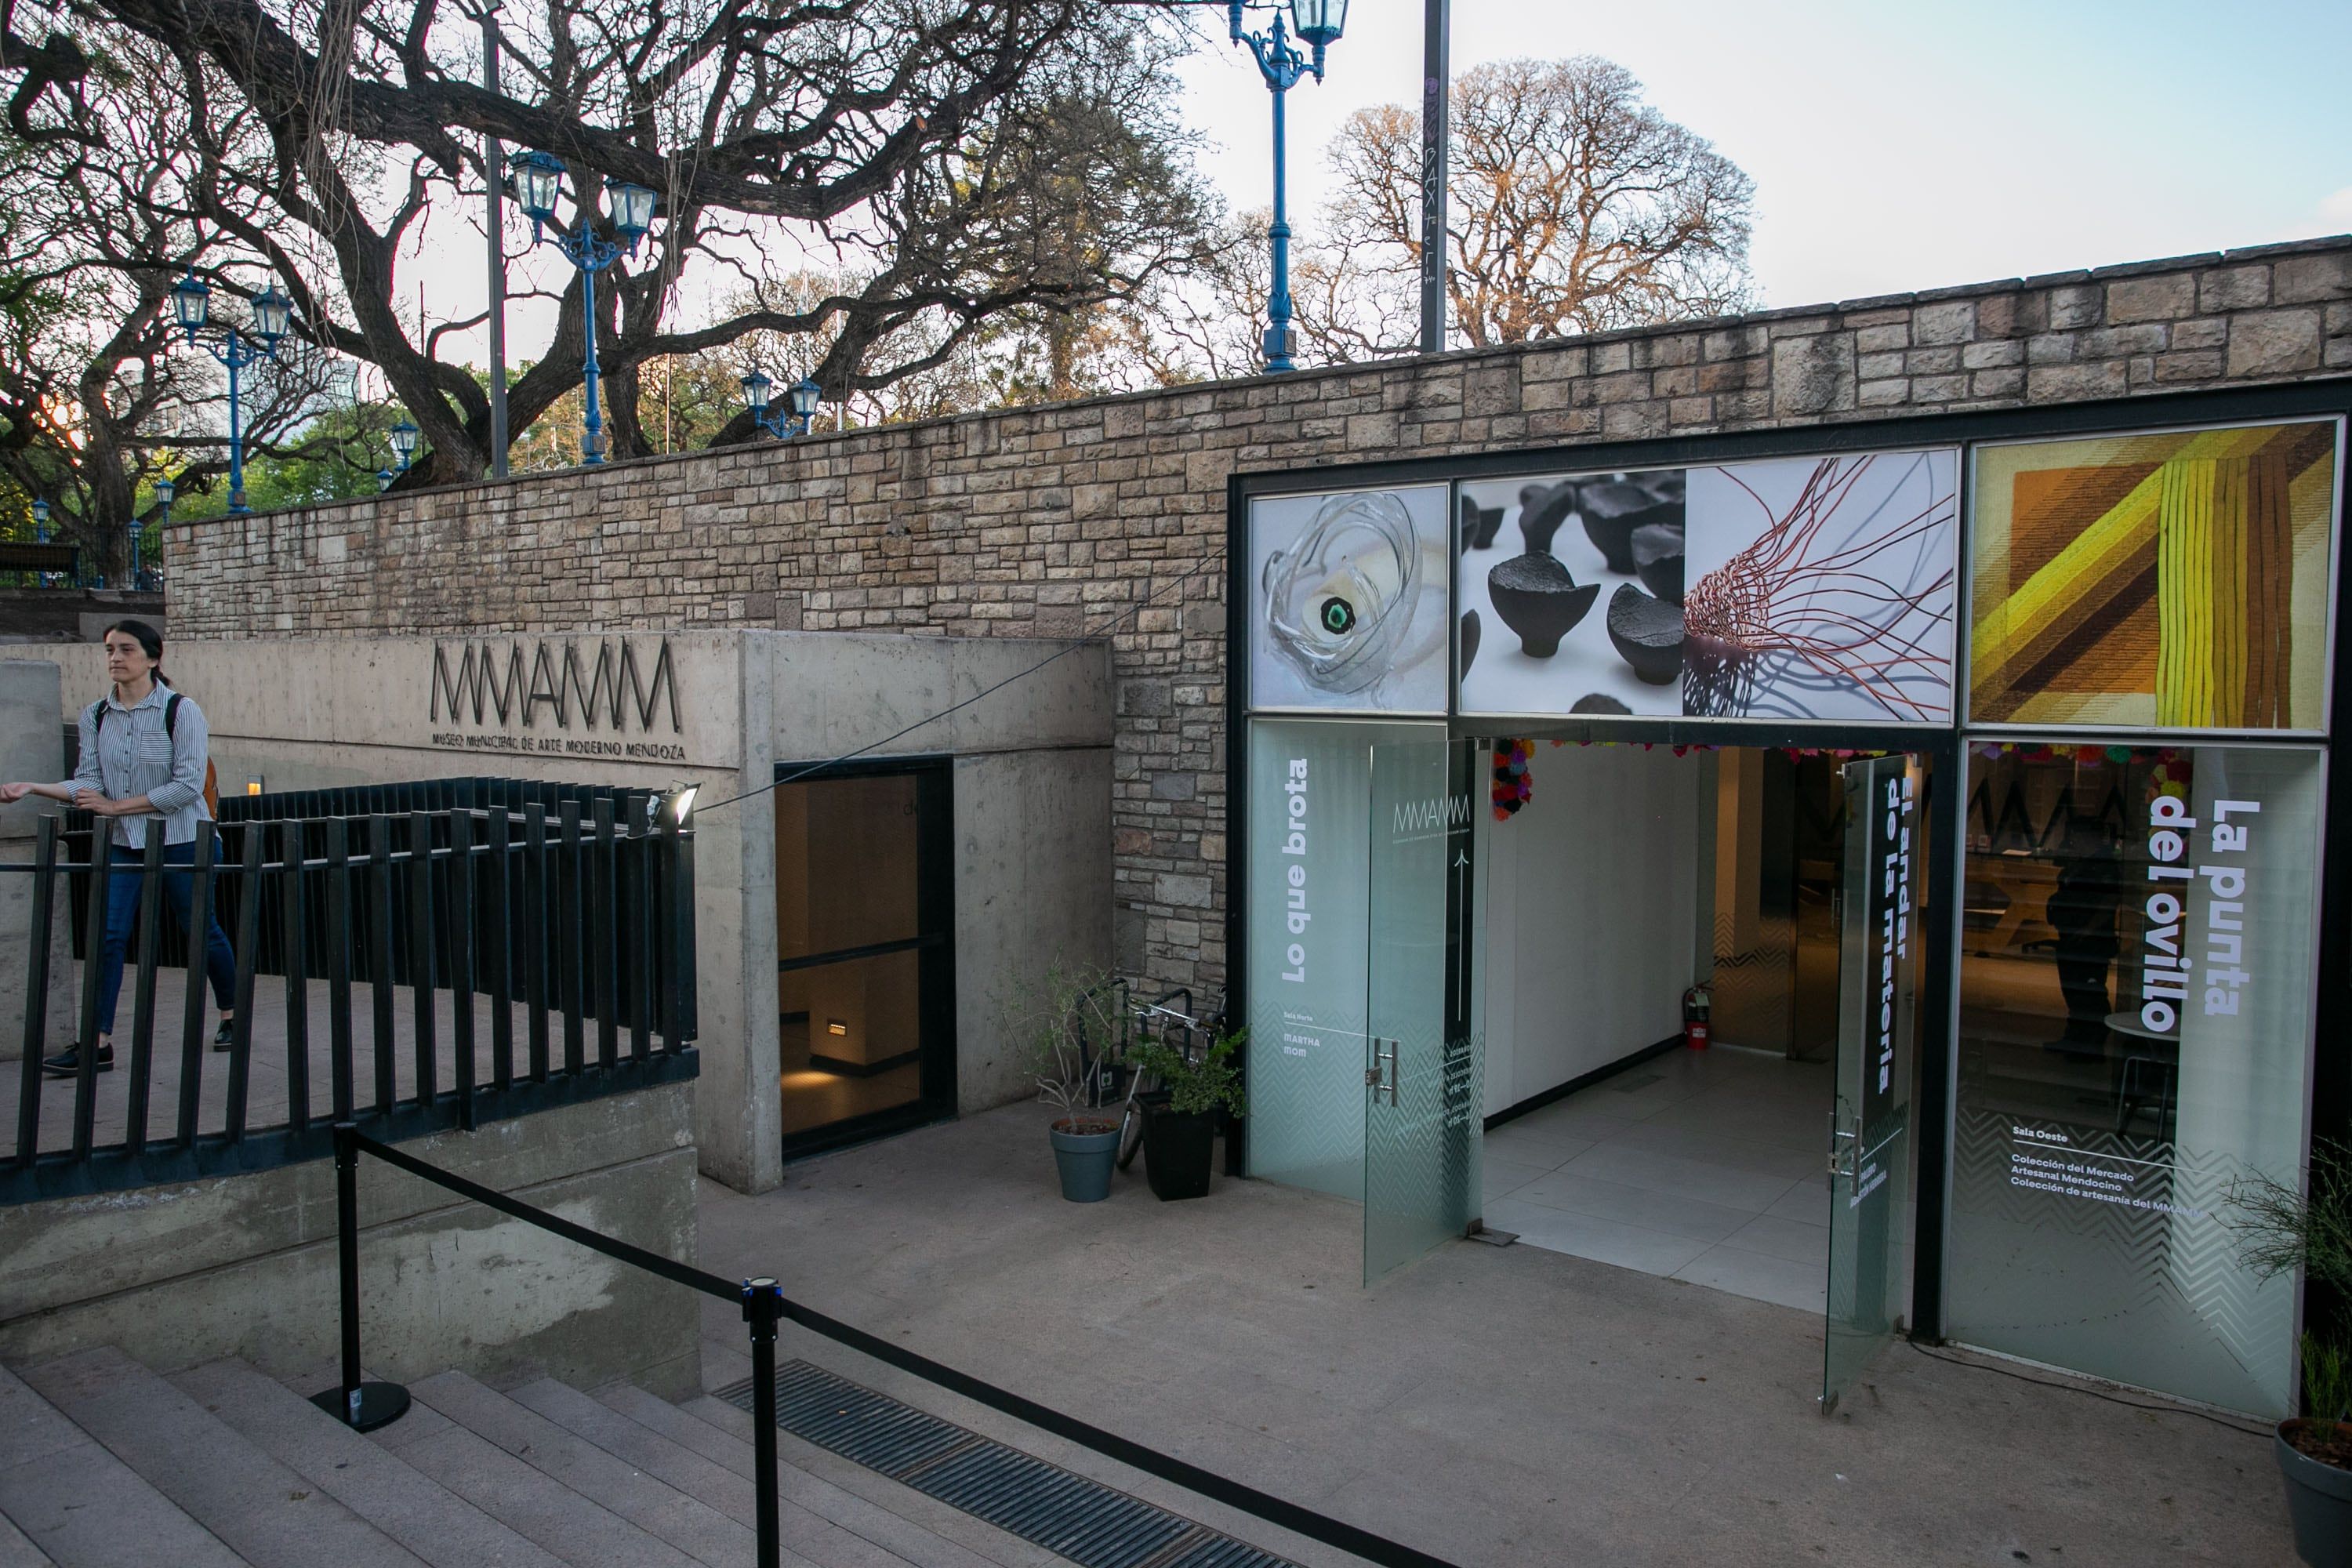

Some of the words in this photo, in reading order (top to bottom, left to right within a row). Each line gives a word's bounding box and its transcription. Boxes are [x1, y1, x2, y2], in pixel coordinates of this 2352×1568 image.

[430, 635, 679, 733] MMAMM
[432, 732, 464, 747] MUSEO
[466, 734, 518, 750] MUNICIPAL
[521, 735, 535, 752] DE
[537, 737, 563, 753] ARTE
[565, 739, 622, 757] MODERNO
[626, 742, 686, 760] MENDOZA
[1282, 758, 1308, 855] brota
[1887, 778, 1900, 842] de
[2212, 799, 2260, 854] La
[2147, 795, 2197, 881] del
[1287, 864, 1312, 935] que
[1885, 852, 1898, 898] la
[1897, 826, 1911, 960] andar
[1282, 943, 1305, 983] Lo
[2140, 892, 2193, 1033] ovillo
[2198, 865, 2250, 1017] punta
[1878, 907, 1895, 1095] materia
[1283, 1033, 1320, 1047] MARTHA
[2013, 1126, 2034, 1137] Sala
[2036, 1130, 2068, 1142] Oeste
[2010, 1176, 2064, 1193] Colección
[2066, 1186, 2080, 1196] de
[2082, 1190, 2131, 1206] artesanía
[2132, 1198, 2151, 1210] del
[2011, 1153, 2065, 1170] Colección
[2067, 1163, 2085, 1174] del
[2086, 1166, 2135, 1182] Mercado
[2011, 1165, 2060, 1181] Artesanal
[2061, 1174, 2122, 1192] Mendocino
